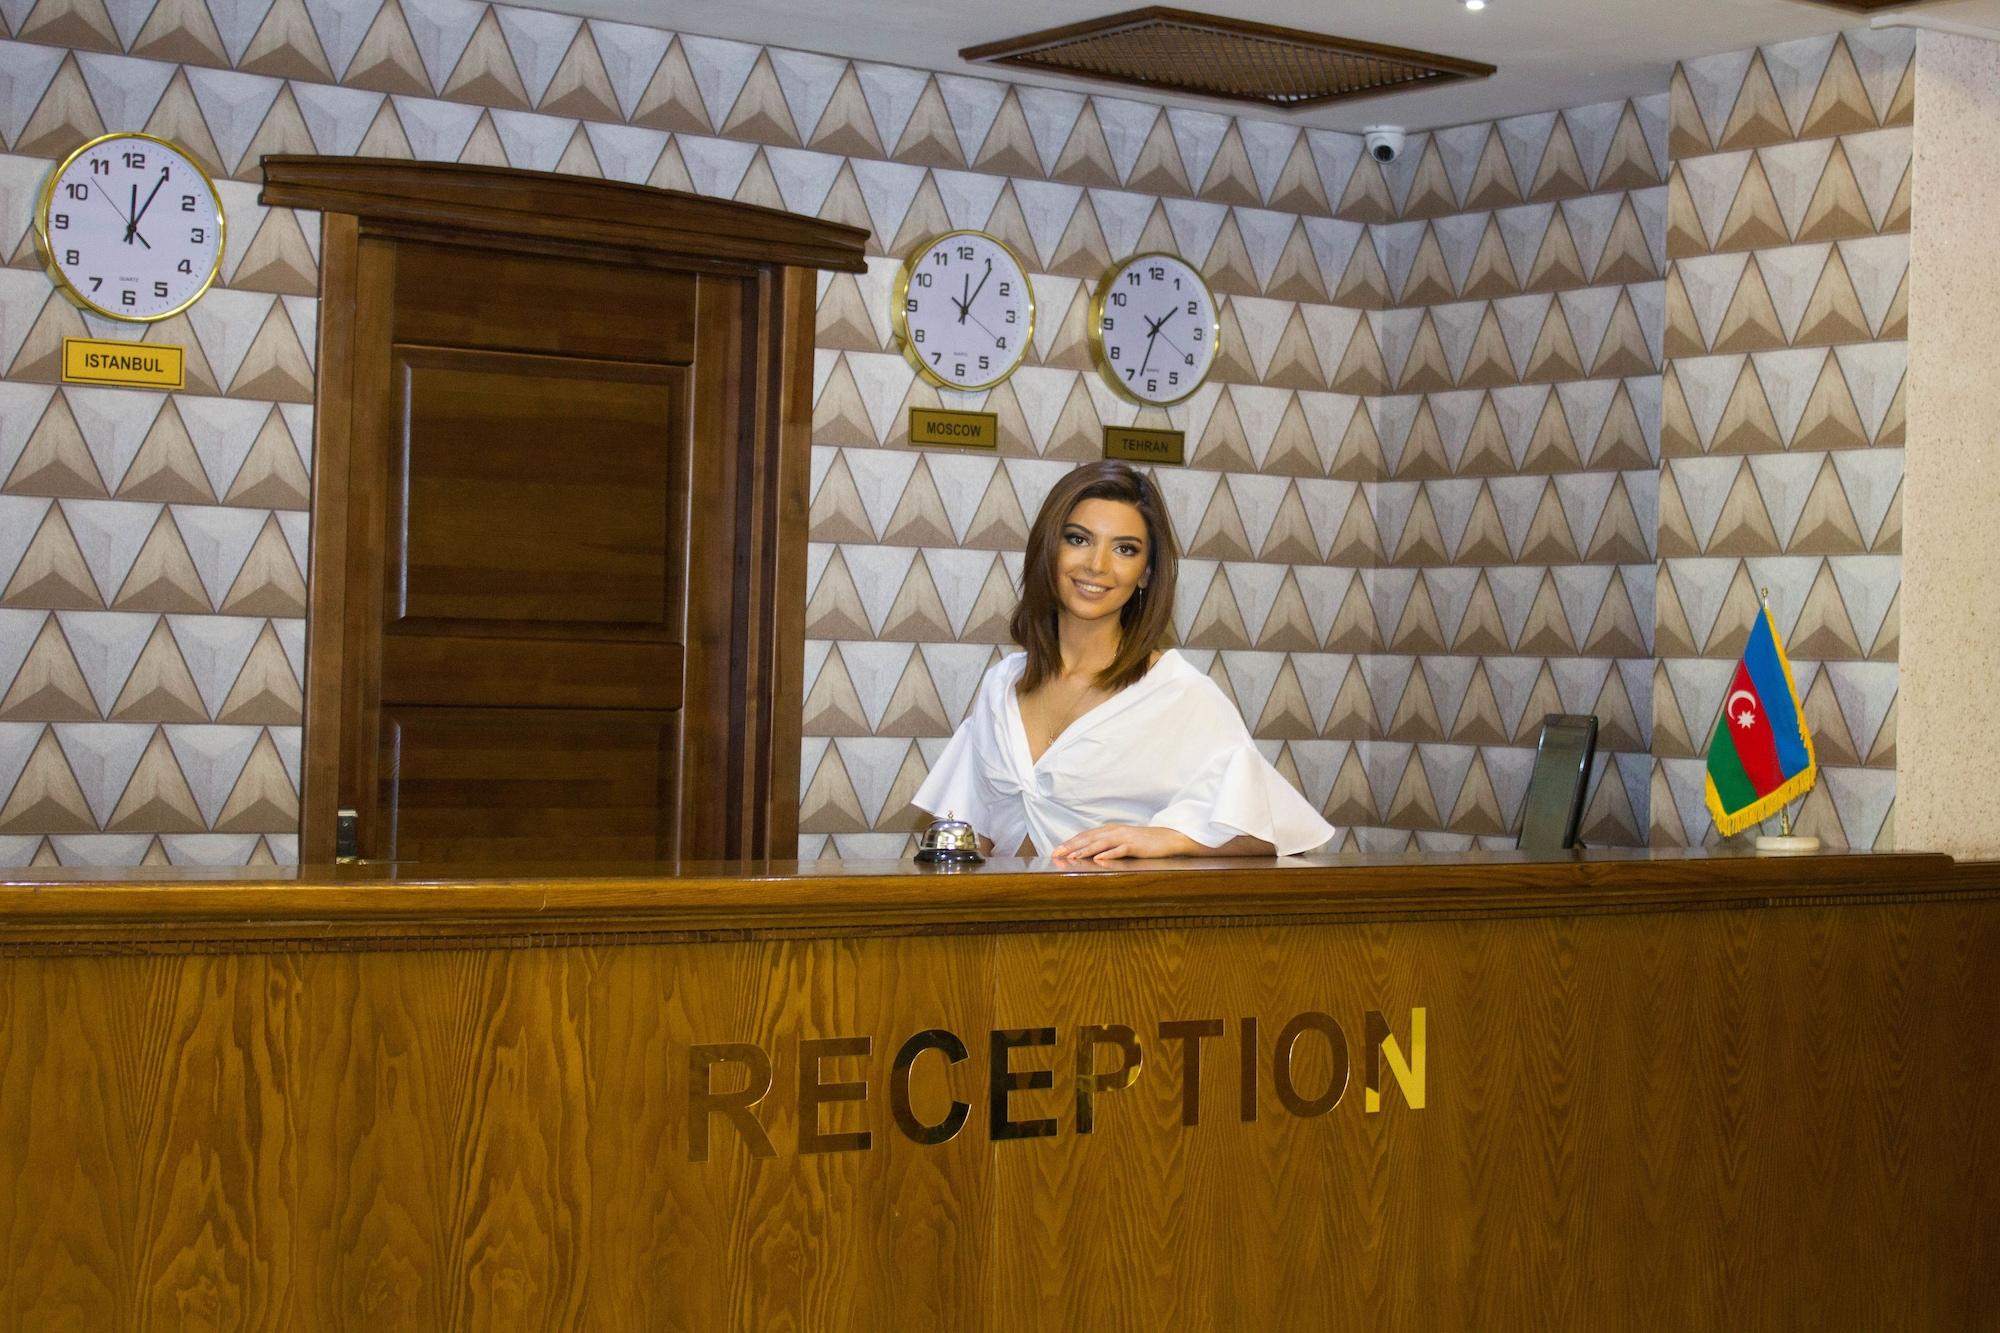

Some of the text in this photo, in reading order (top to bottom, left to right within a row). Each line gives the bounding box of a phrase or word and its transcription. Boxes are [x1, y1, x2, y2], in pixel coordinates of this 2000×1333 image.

[90, 159, 109, 175] 11
[122, 153, 145, 169] 12
[161, 166, 170, 181] 1
[66, 183, 88, 200] 10
[182, 195, 195, 211] 2
[55, 214, 69, 229] 9
[191, 228, 204, 243] 3
[66, 250, 79, 265] 8
[933, 252, 948, 266] 11
[957, 247, 974, 260] 12
[177, 260, 192, 274] 4
[985, 258, 992, 272] 1
[1127, 273, 1140, 286] 11
[1148, 267, 1164, 280] 12
[89, 277, 103, 292] 7
[916, 273, 932, 288] 10
[1174, 278, 1180, 291] 1
[154, 281, 168, 298] 5
[1000, 283, 1010, 296] 2
[122, 291, 136, 306] 6
[1111, 293, 1127, 307] 10
[907, 300, 917, 312] 9
[1188, 302, 1197, 315] 2
[1006, 310, 1015, 323] 3
[1104, 318, 1114, 330] 9
[915, 330, 925, 343] 8
[1194, 329, 1203, 341] 3
[996, 337, 1006, 350] 4
[931, 352, 941, 365] 7
[1110, 347, 1120, 359] 8
[1185, 353, 1194, 366] 4
[85, 353, 164, 372] ISTANBUL
[979, 356, 989, 369] 5
[955, 364, 965, 376] 6
[1126, 369, 1135, 381] 7
[1169, 372, 1178, 384] 5
[1147, 380, 1157, 392] 6
[927, 422, 982, 437] MOSCOW
[1122, 439, 1169, 453] TEHRAN
[689, 1006, 1426, 1162] RECEPTION
